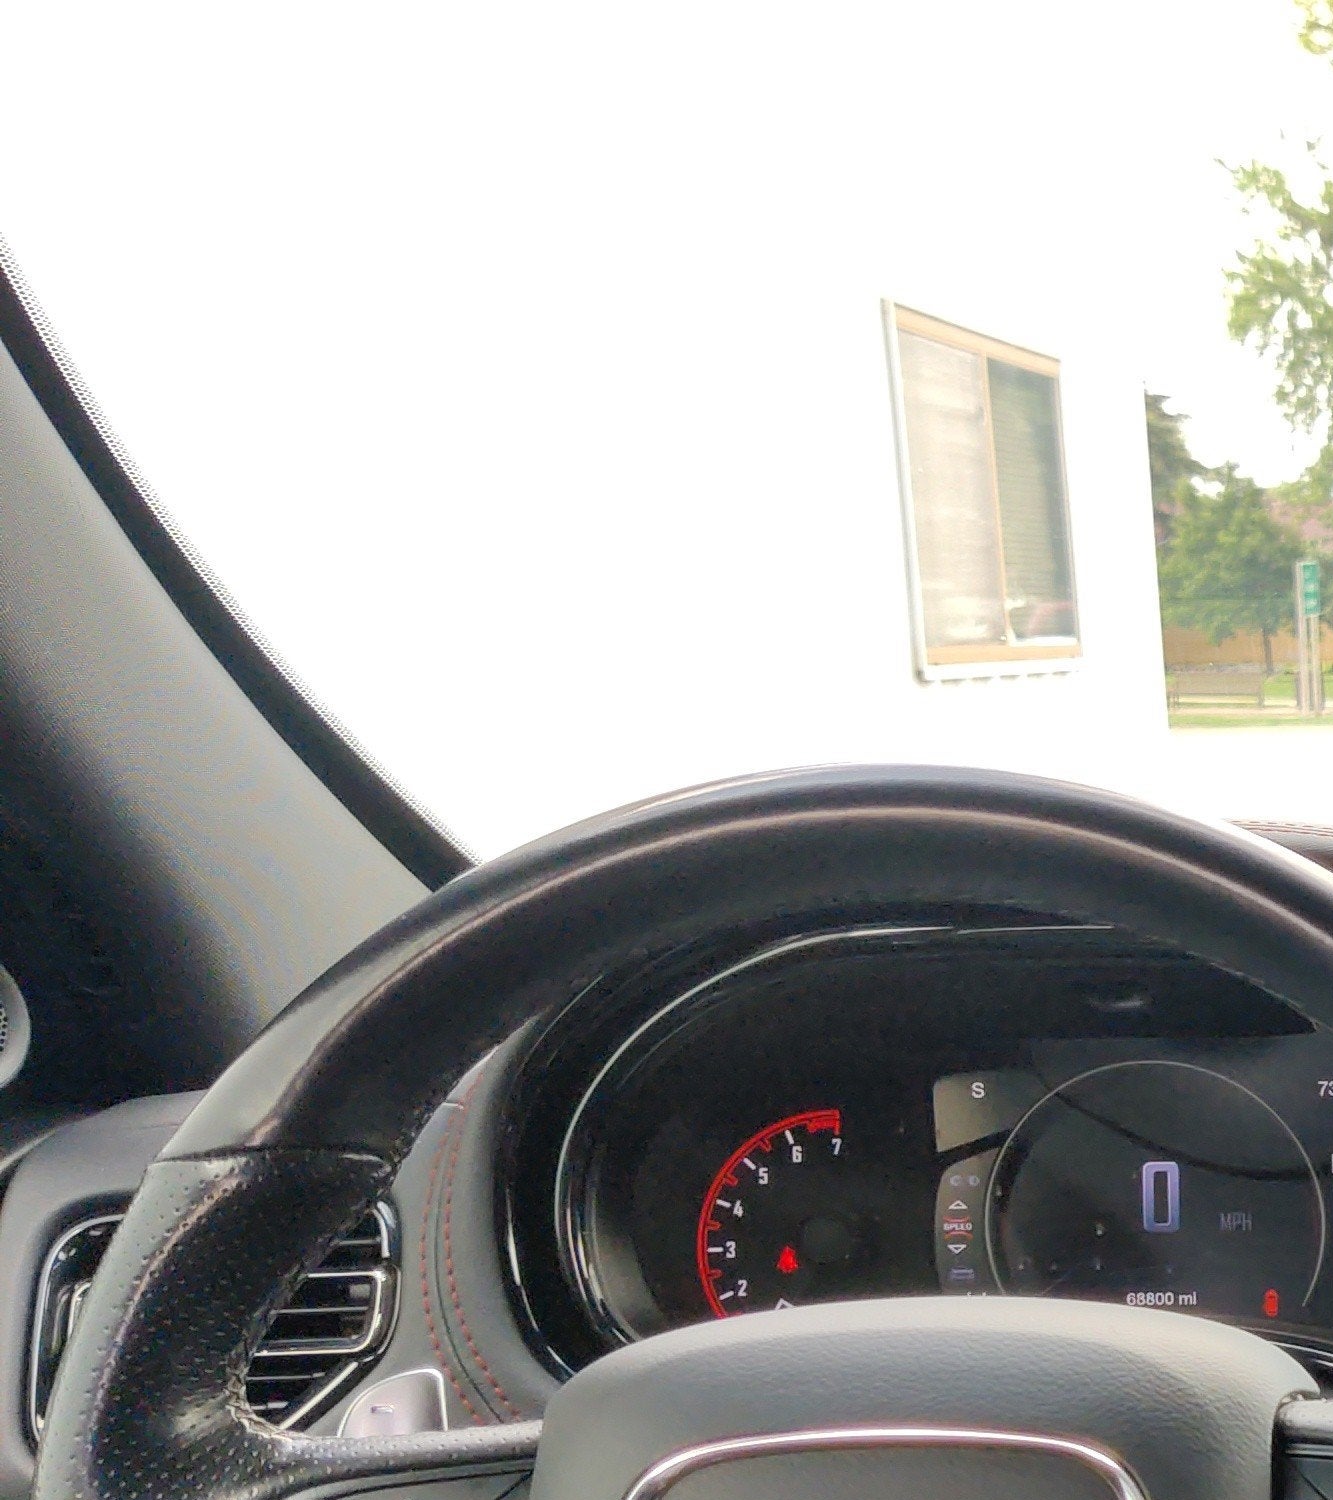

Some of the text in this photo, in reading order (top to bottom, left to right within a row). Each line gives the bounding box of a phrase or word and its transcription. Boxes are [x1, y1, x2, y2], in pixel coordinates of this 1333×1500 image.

[971, 1081, 986, 1100] S
[792, 1146, 802, 1163] 6
[832, 1138, 842, 1155] 7
[758, 1168, 769, 1185] 5
[1142, 1161, 1180, 1232] 0
[733, 1200, 744, 1217] 4
[1220, 1212, 1252, 1231] MPH
[726, 1241, 736, 1259] 3
[737, 1280, 747, 1297] 2
